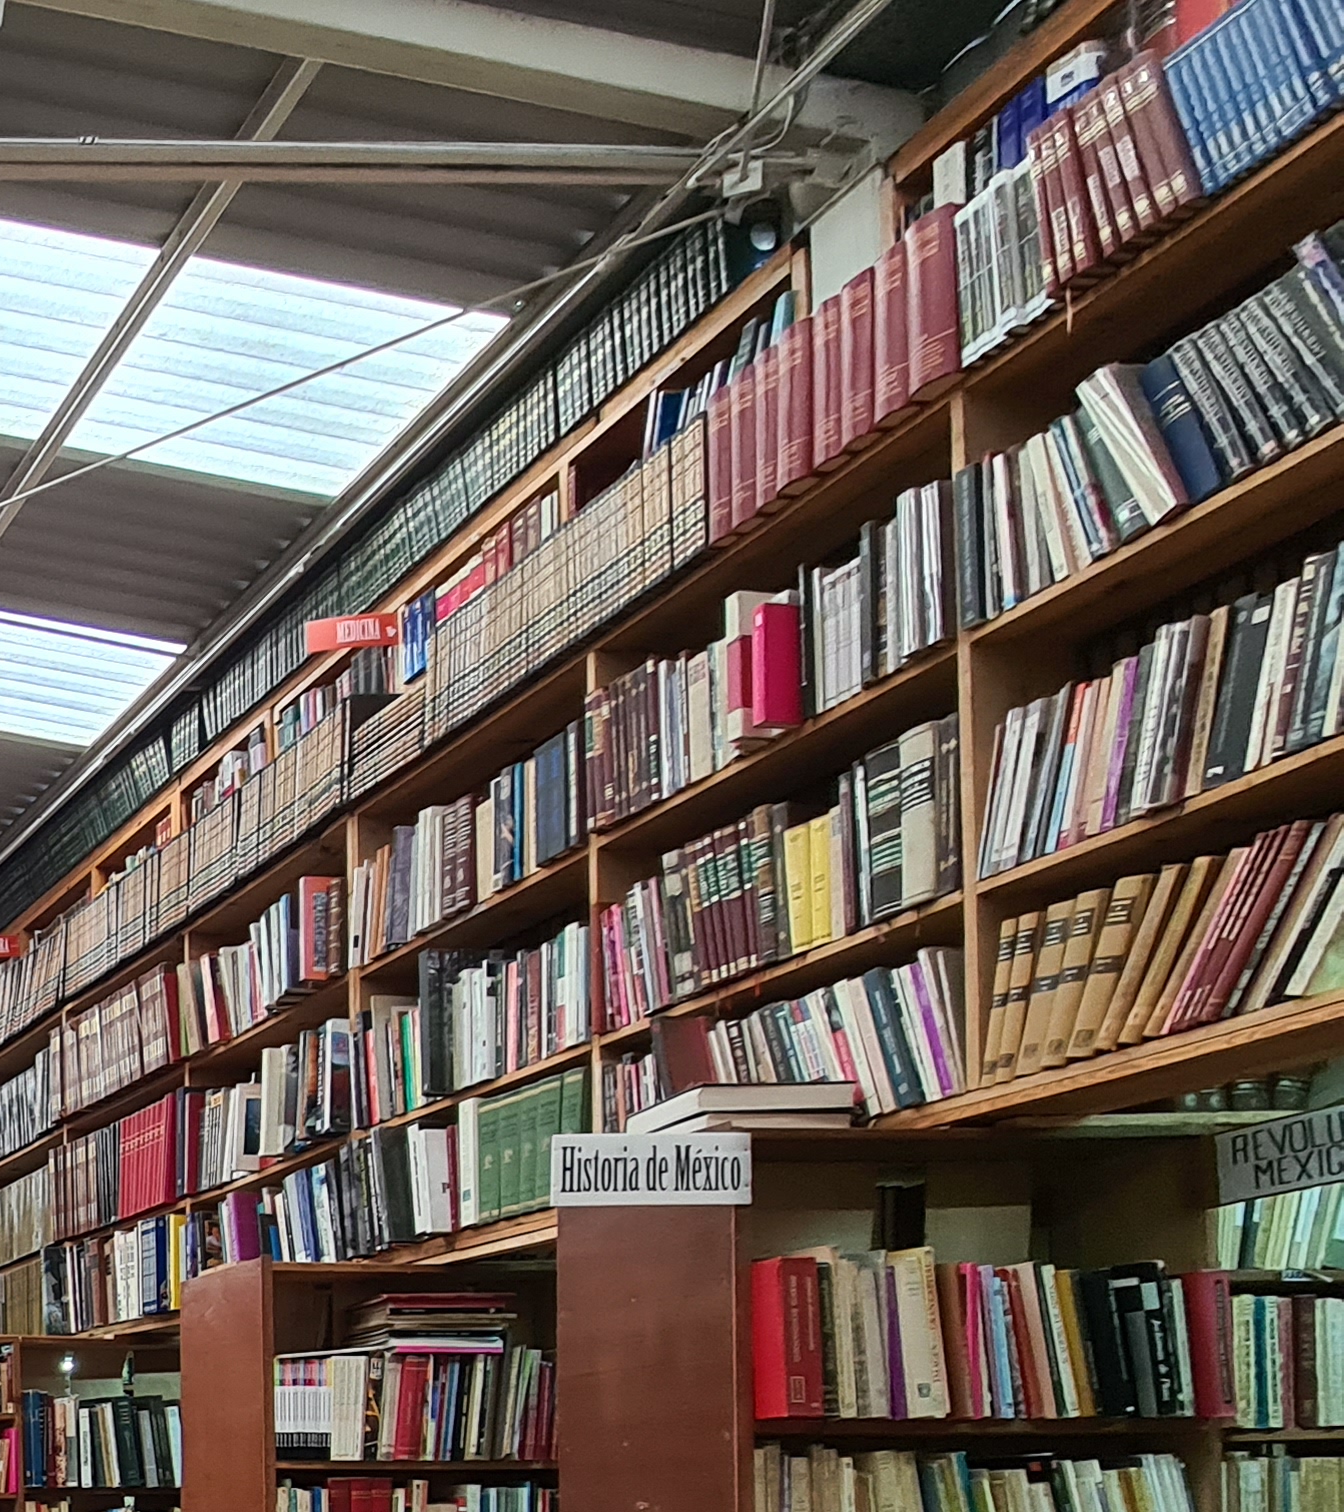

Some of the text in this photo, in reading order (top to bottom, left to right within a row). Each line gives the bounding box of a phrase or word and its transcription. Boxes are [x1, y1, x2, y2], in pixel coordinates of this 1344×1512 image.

[335, 617, 380, 643] MEDICINA
[560, 1141, 742, 1195] Historia de México
